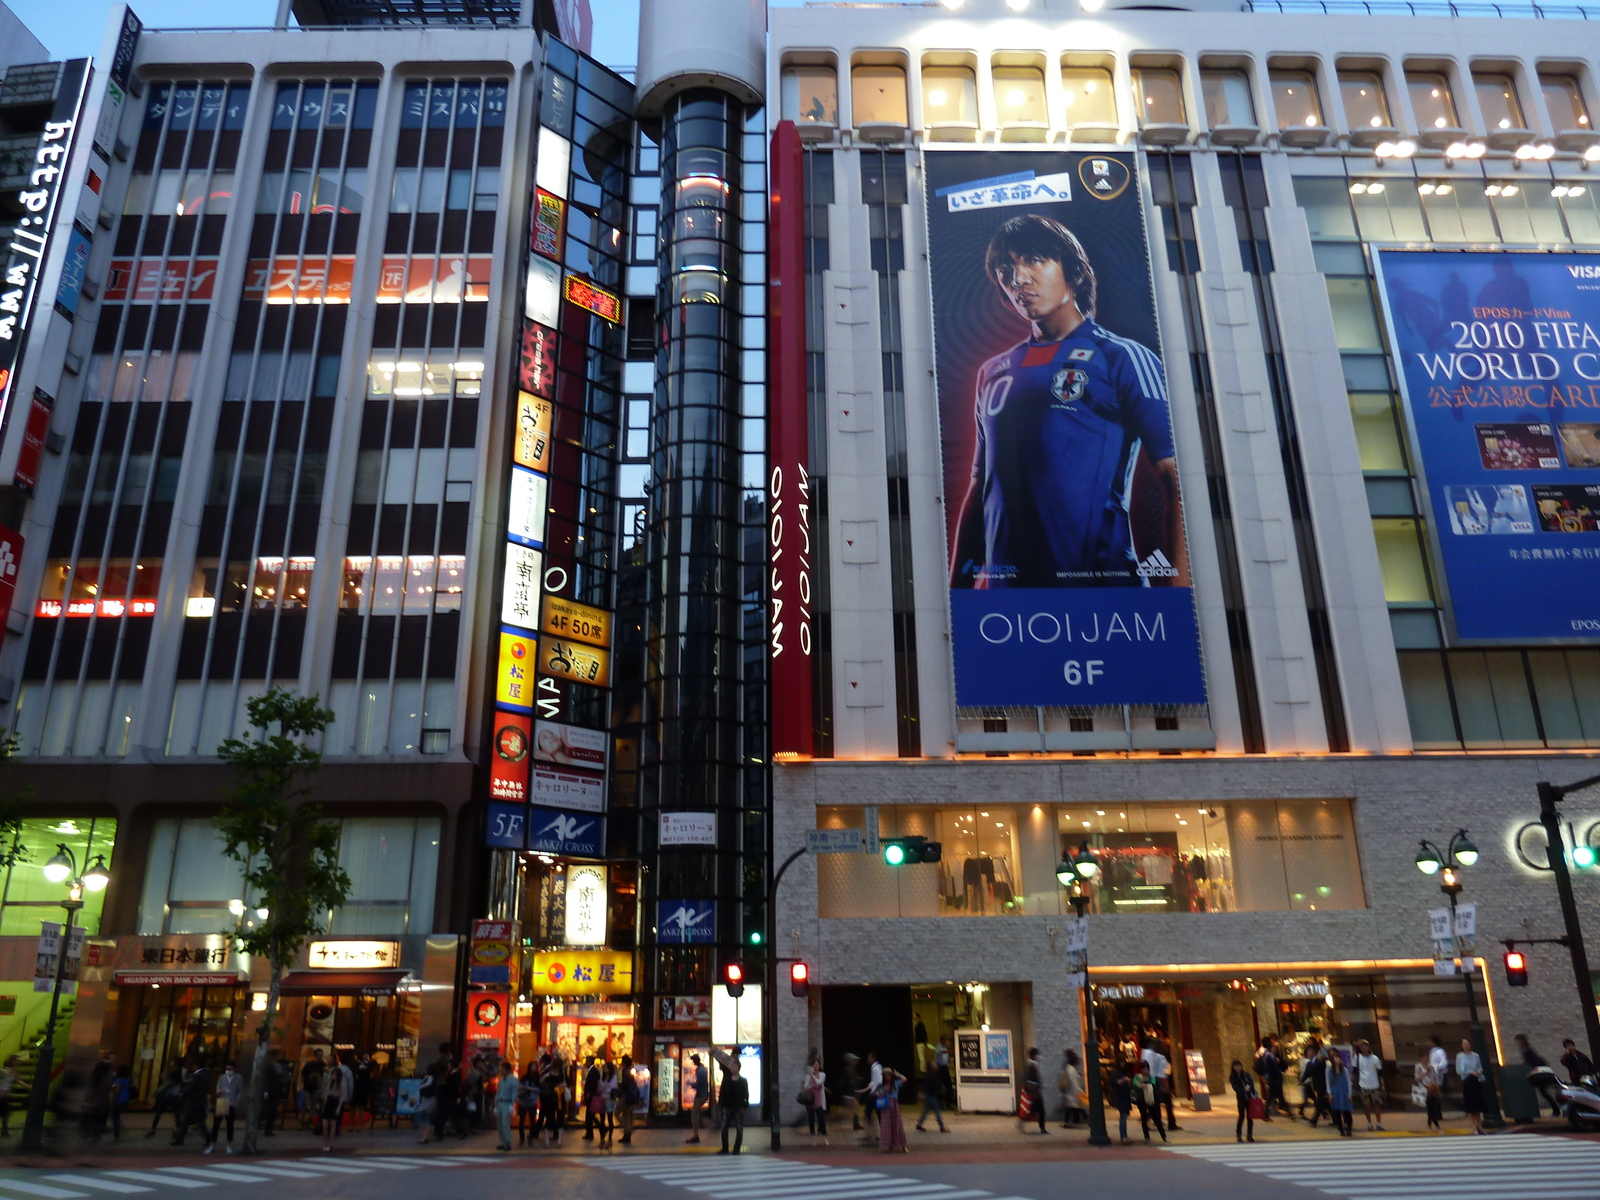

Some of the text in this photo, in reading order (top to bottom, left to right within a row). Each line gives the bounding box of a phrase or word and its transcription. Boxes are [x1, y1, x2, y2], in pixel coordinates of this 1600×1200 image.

[150, 102, 349, 119] ダンディ ハウス
[951, 184, 1069, 208] いざ革命へ。
[1450, 320, 1525, 349] 2010
[1416, 352, 1600, 381] WORLD C
[1050, 403, 1078, 412] JAPAN
[797, 462, 811, 554] JAM
[1135, 566, 1180, 578] adidas
[551, 614, 569, 630] 4F
[771, 567, 784, 659] JAM
[1081, 611, 1167, 643] JAM
[508, 663, 525, 699] 松屋
[1063, 659, 1105, 686] 6F
[492, 812, 524, 838] 5F
[565, 840, 595, 853] CROSS
[141, 948, 227, 964] 東日本銀行
[174, 976, 192, 984] BANK
[572, 963, 616, 982] 松屋
